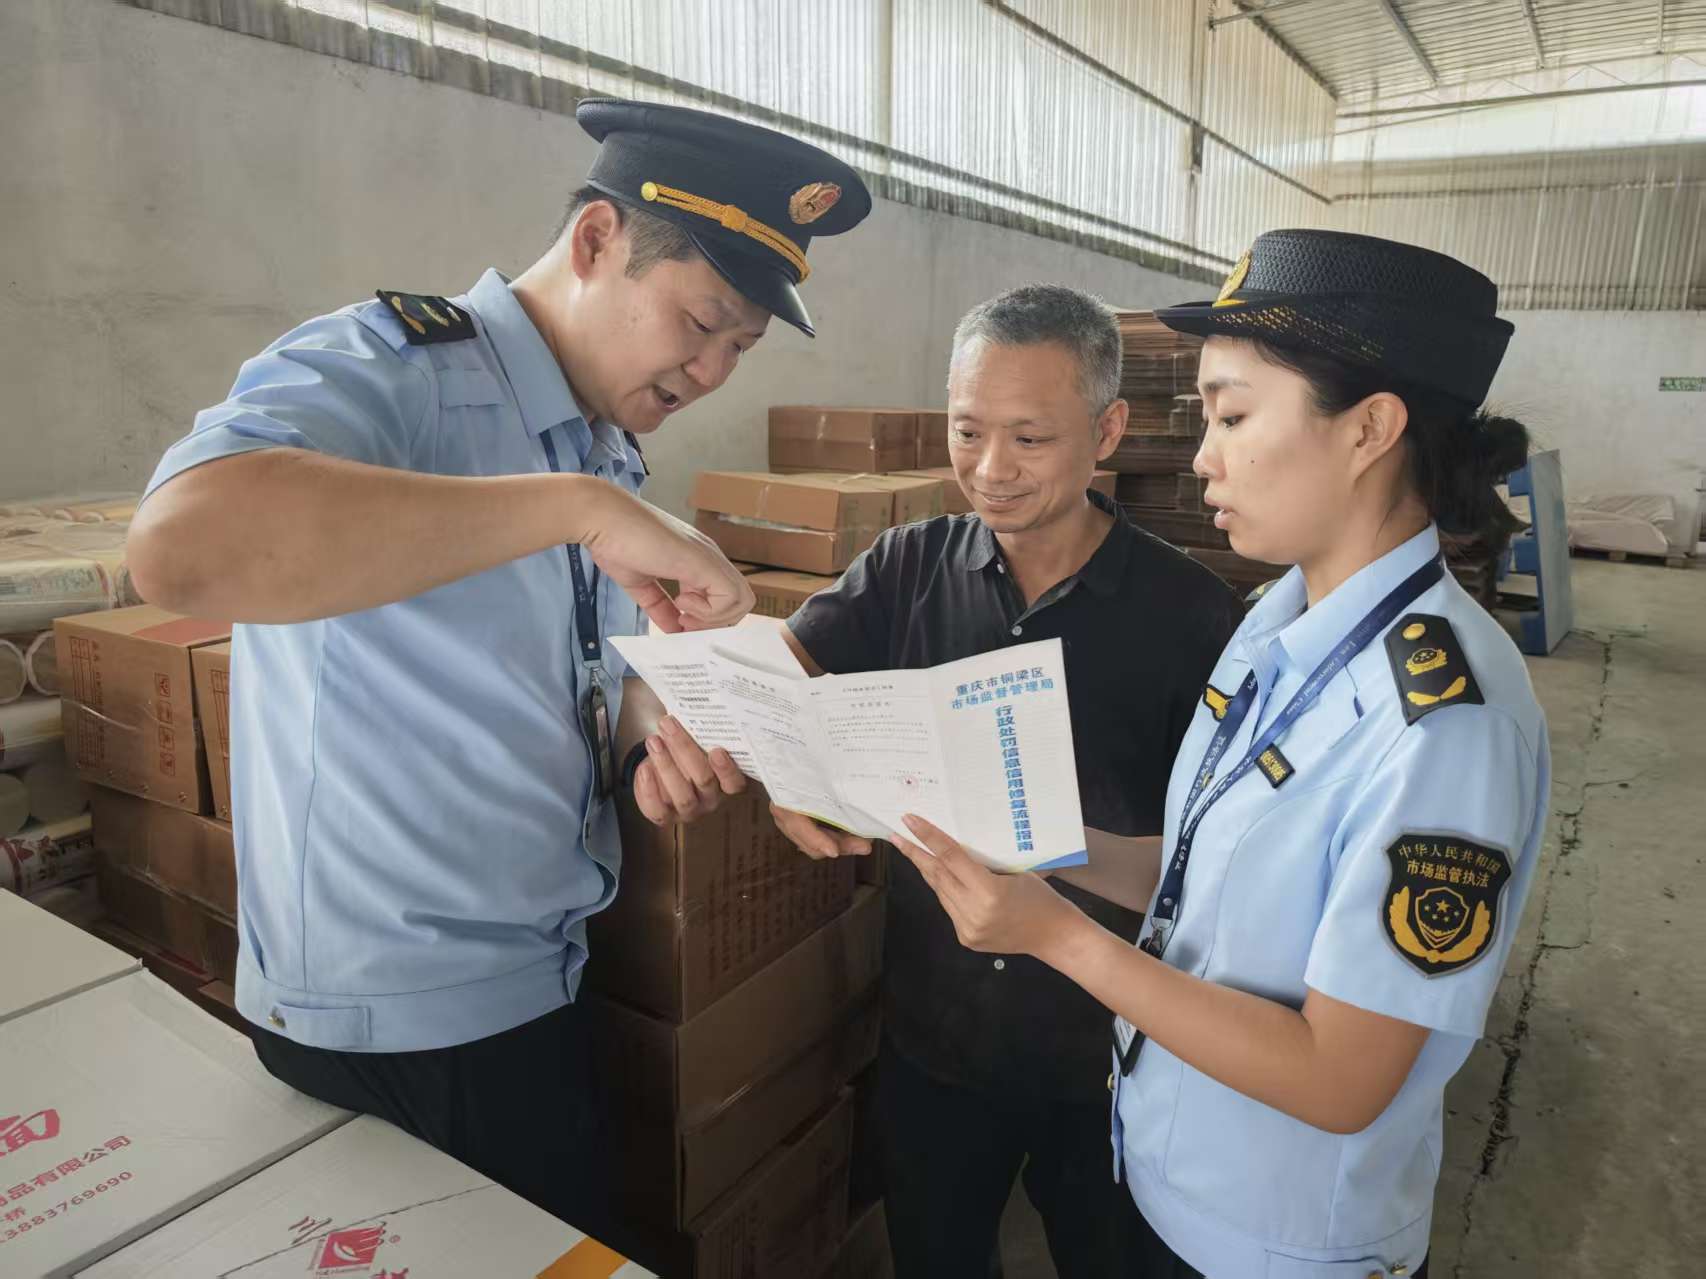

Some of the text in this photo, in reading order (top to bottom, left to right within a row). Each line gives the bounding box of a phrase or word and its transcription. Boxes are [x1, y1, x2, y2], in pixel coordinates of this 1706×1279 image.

[1398, 843, 1502, 874] 中华人民共和国
[1407, 859, 1490, 888] 市场监管执法
[0, 1135, 131, 1207] 品有限公司
